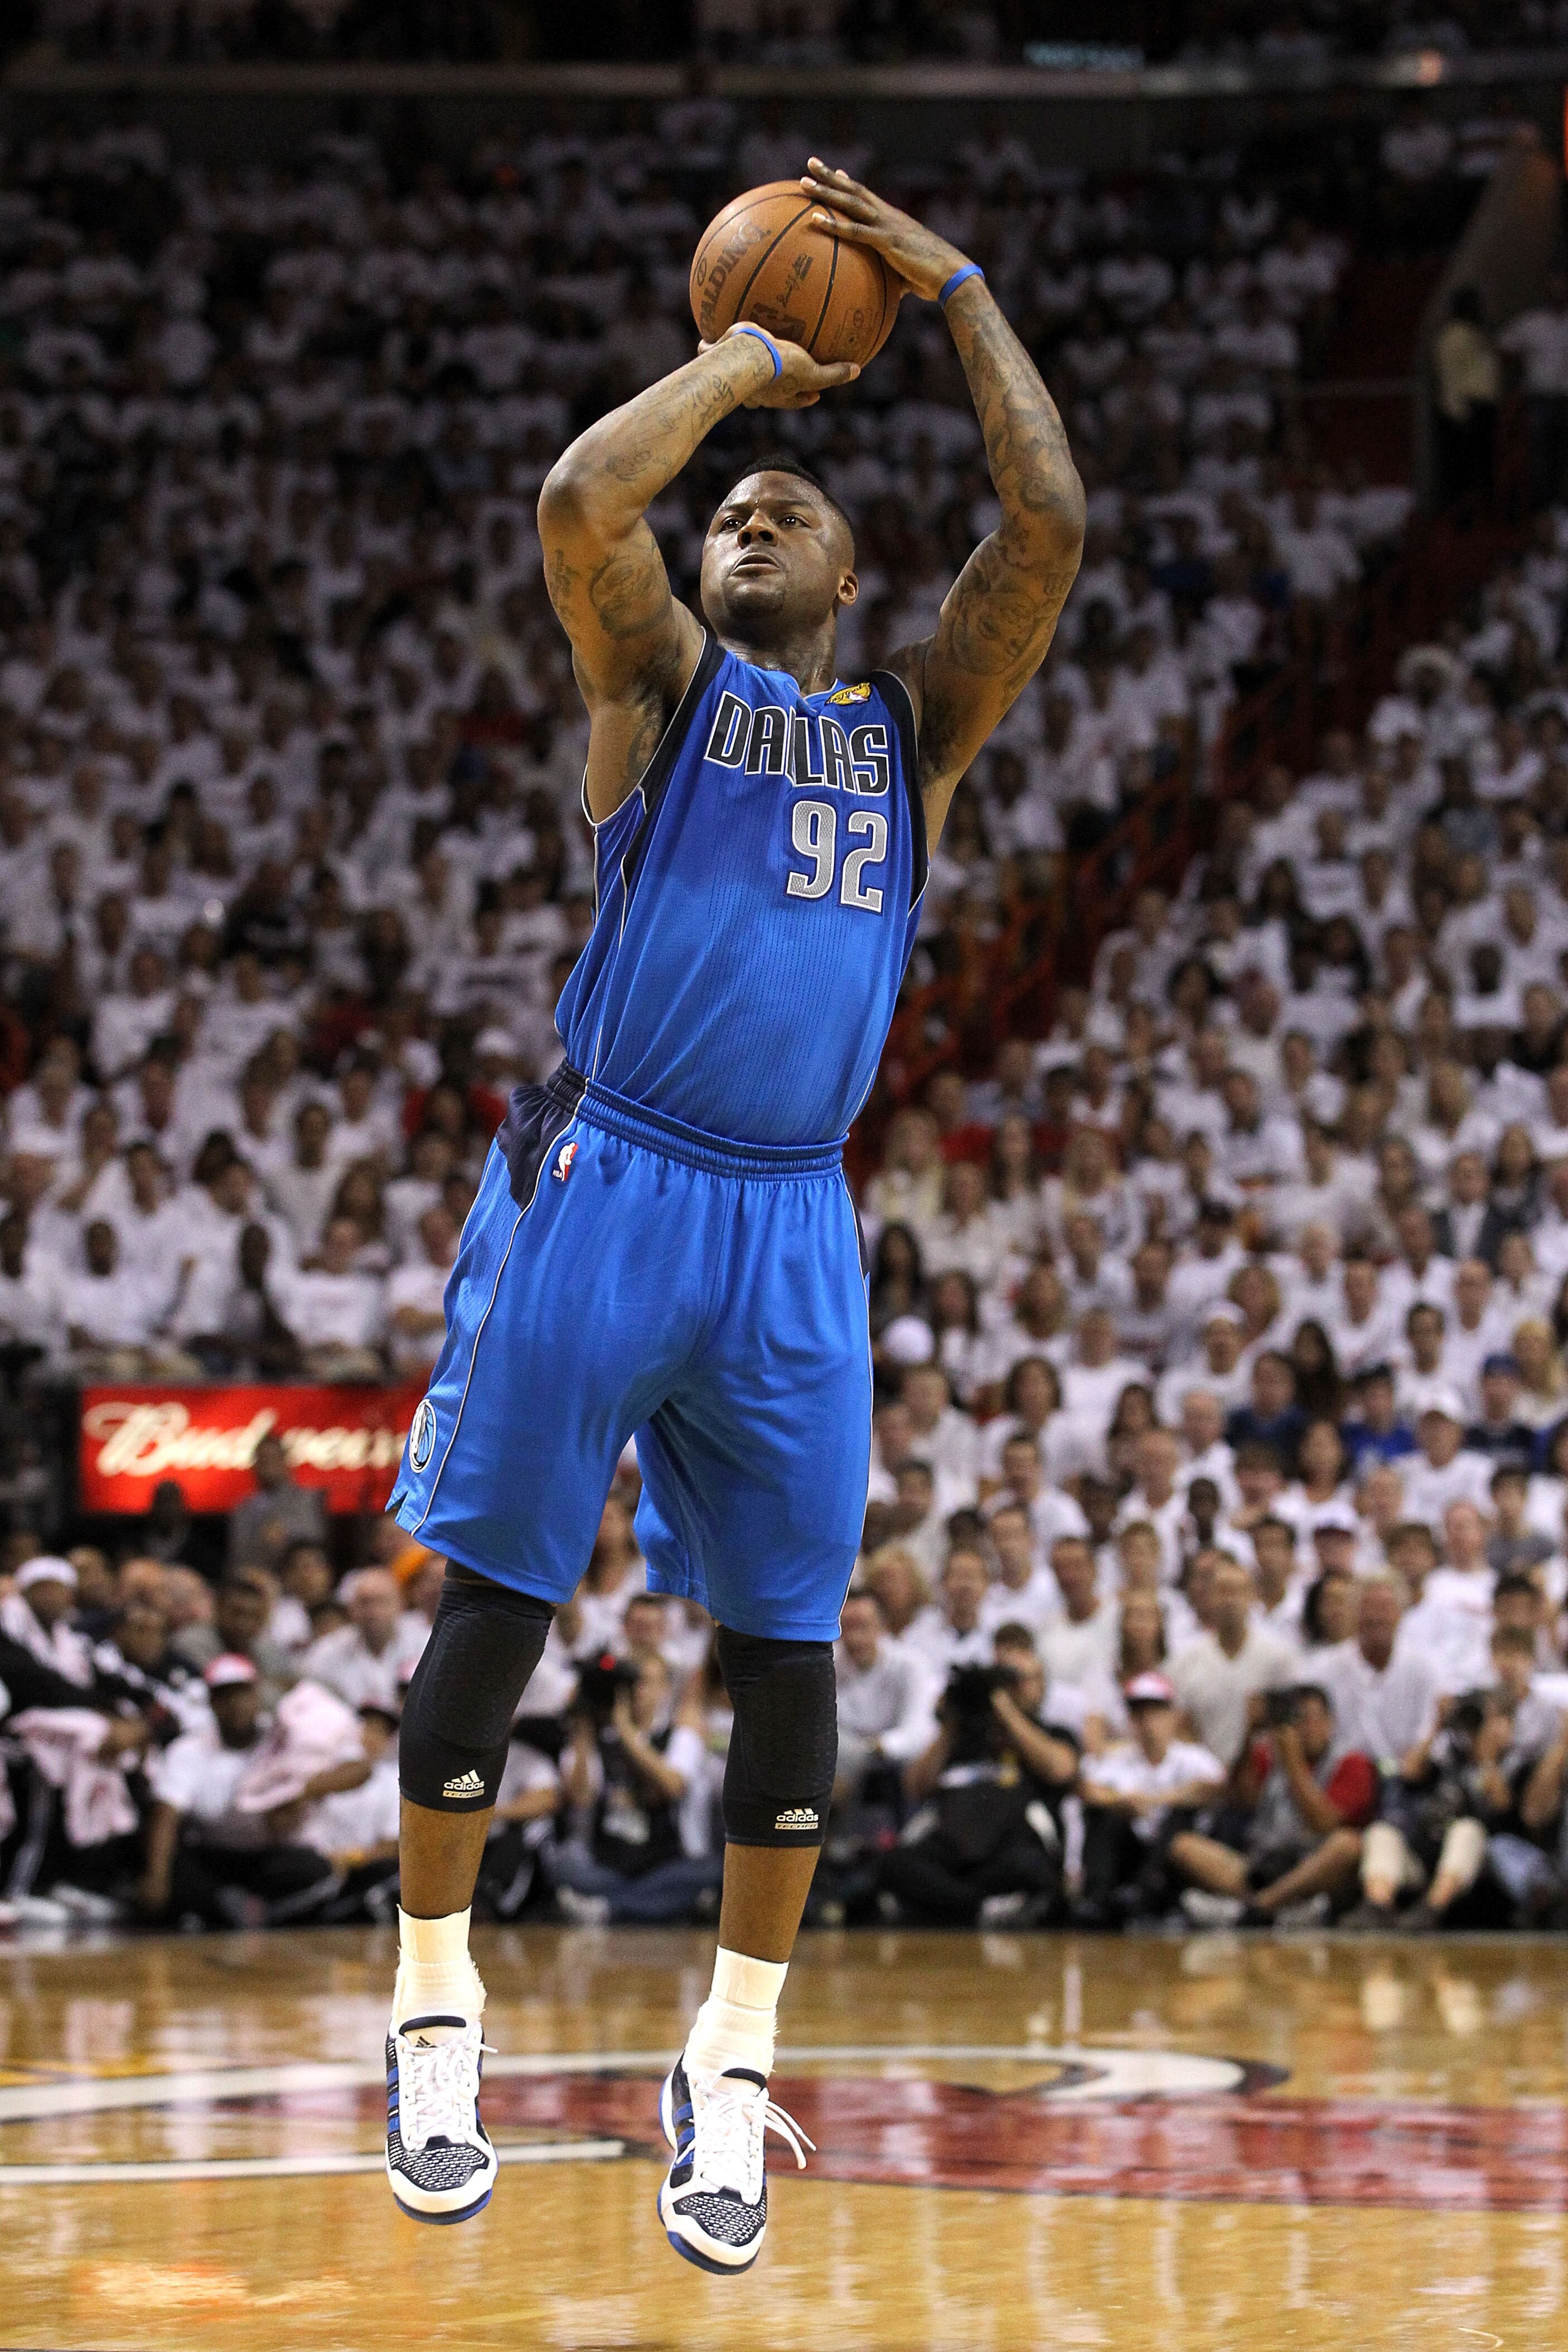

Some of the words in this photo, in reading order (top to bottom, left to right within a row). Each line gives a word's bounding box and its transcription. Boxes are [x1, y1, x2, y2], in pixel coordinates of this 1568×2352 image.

[786, 800, 888, 913] 92
[553, 1170, 562, 1178] NBA
[444, 1781, 485, 1790] adidas
[776, 1814, 819, 1822] adidas
